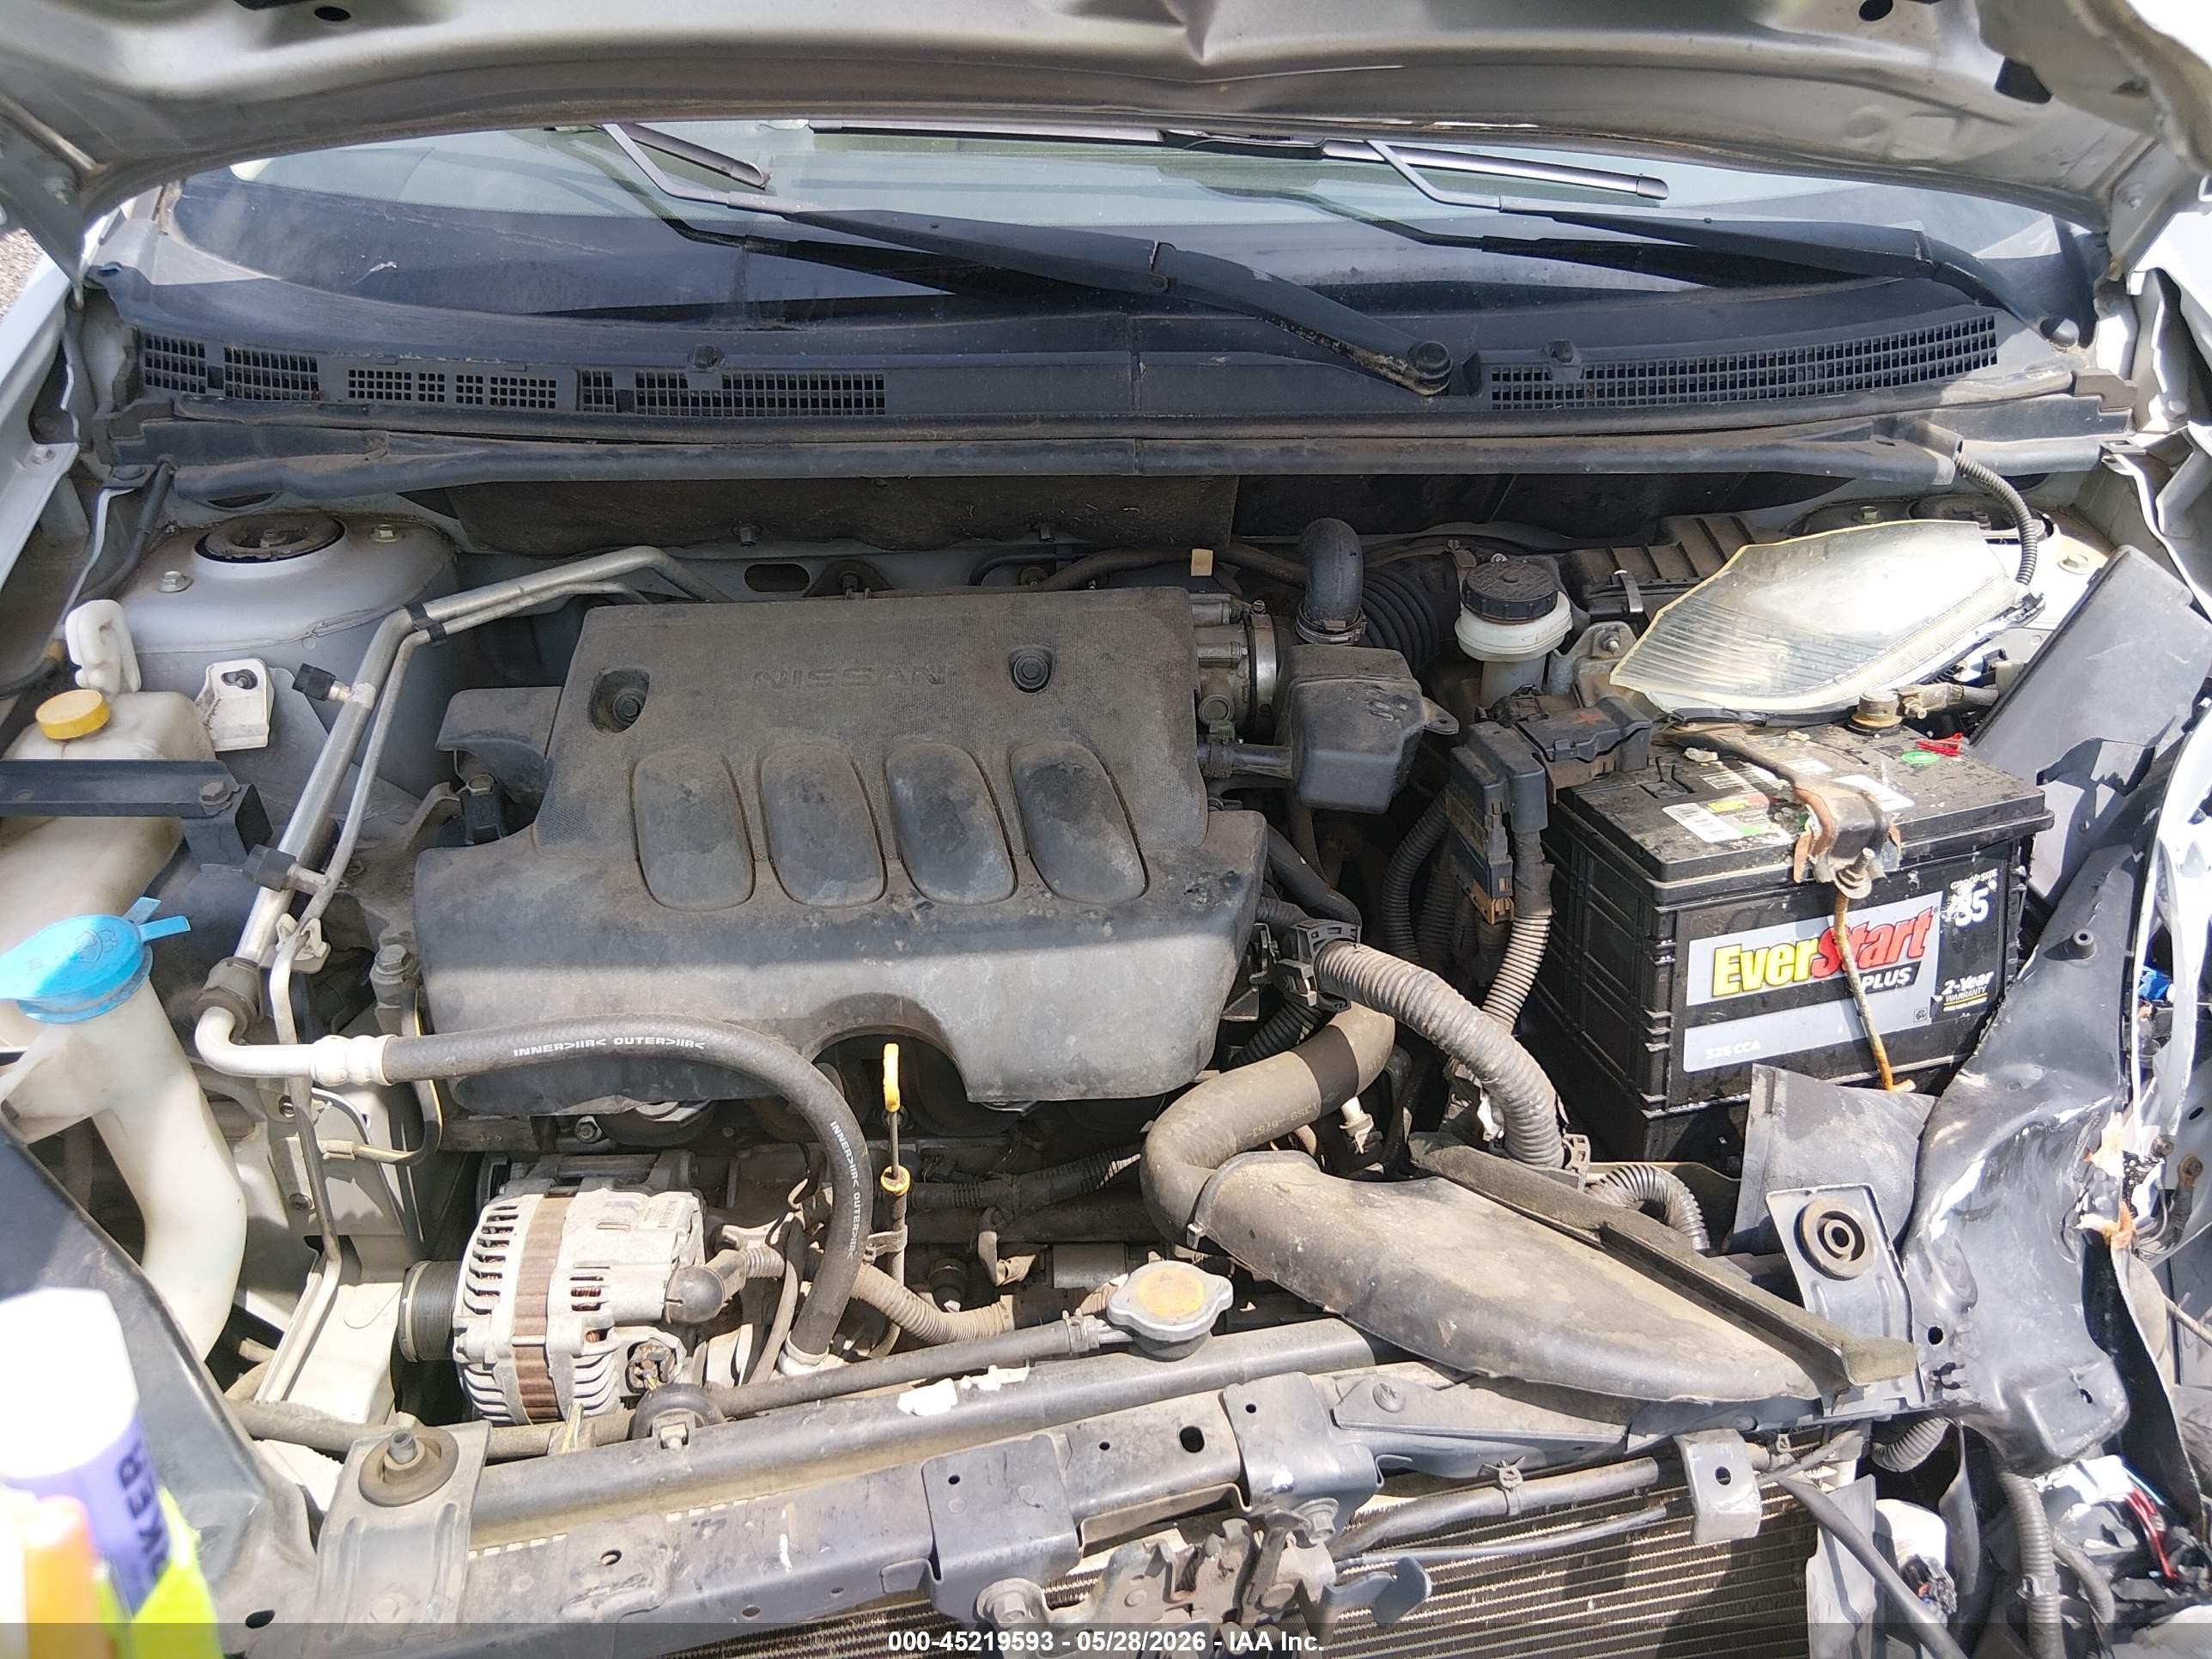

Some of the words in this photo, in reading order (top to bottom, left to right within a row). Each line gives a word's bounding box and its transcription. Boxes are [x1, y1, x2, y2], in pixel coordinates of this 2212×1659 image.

[753, 664, 946, 690] NISSAN
[1711, 907, 1934, 998] EverStart
[1862, 966, 1913, 991] PLUS
[1942, 971, 1994, 995] 2-Year
[1946, 985, 1988, 1003] WARRANTY
[1733, 1039, 1760, 1054] CCA
